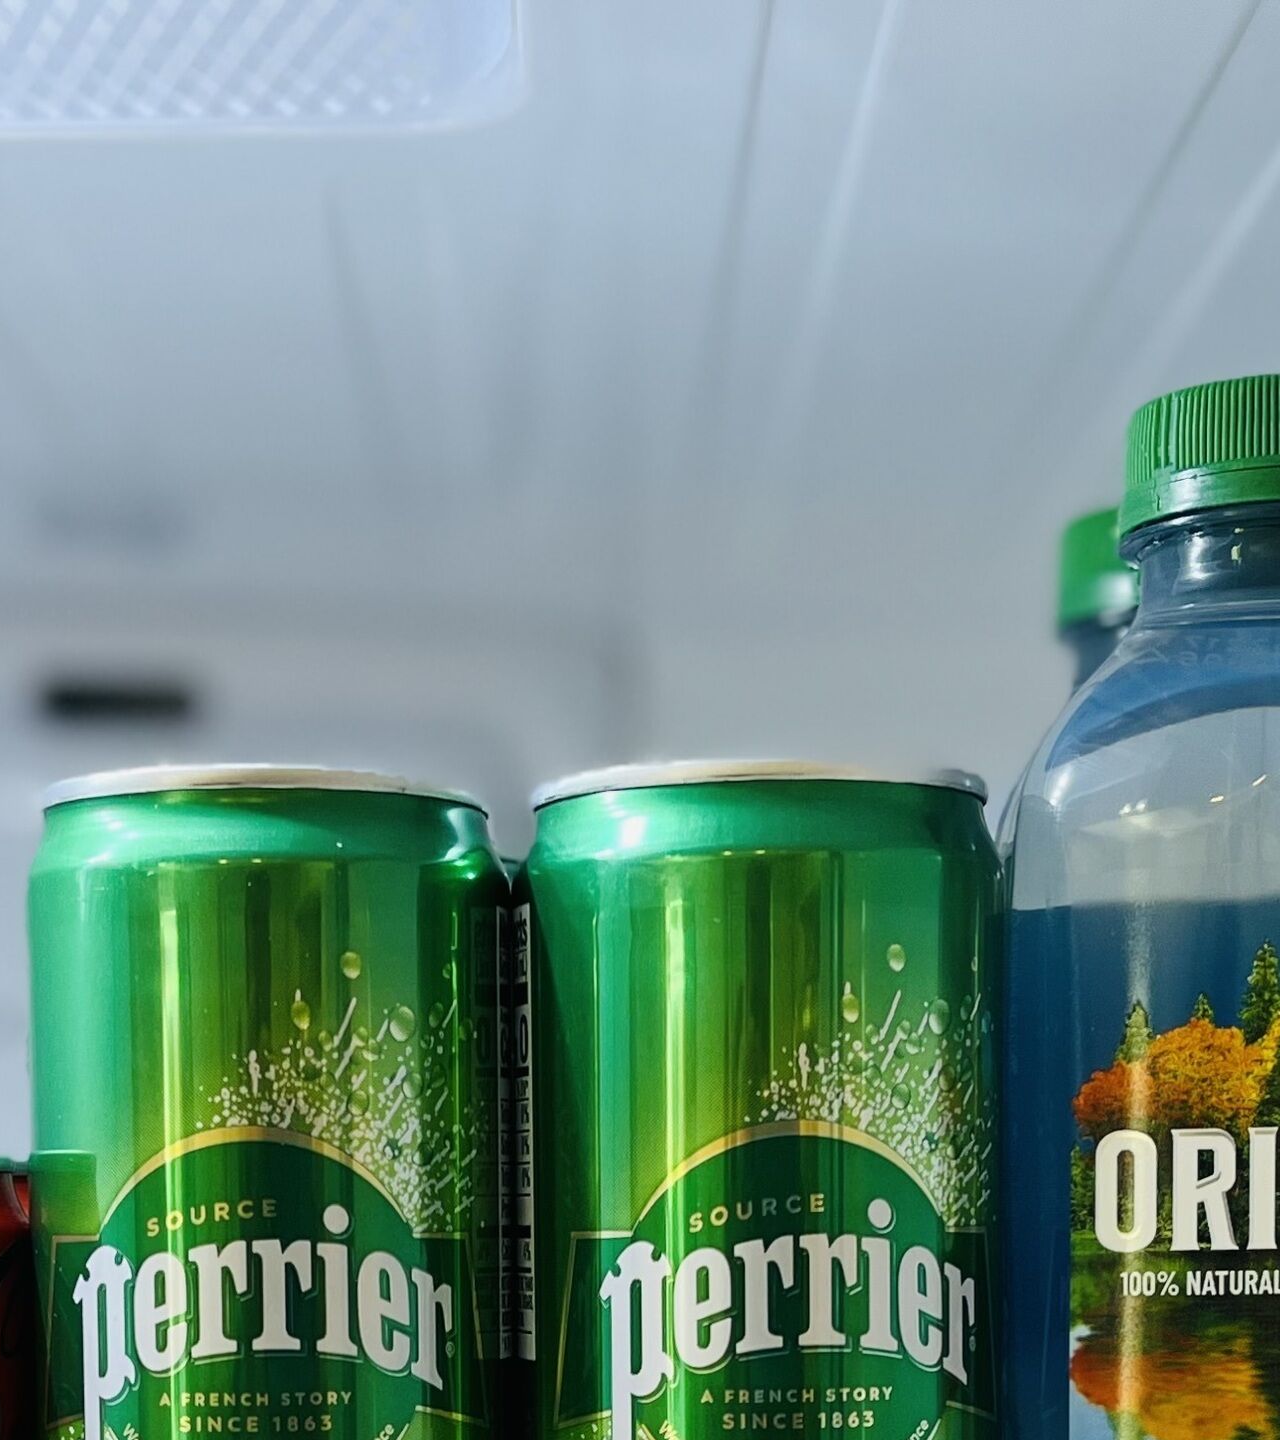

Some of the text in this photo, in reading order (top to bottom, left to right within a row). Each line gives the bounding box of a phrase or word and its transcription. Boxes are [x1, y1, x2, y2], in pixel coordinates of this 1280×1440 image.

[146, 1199, 278, 1237] SOURCE
[689, 1193, 825, 1234] SOURCE
[1120, 1270, 1179, 1297] 100%
[159, 1391, 353, 1407] A FRENCH STORY
[700, 1386, 894, 1405] A FRENCH STORY
[178, 1414, 333, 1433] SINCE 1863
[722, 1410, 875, 1431] SINCE 1863
